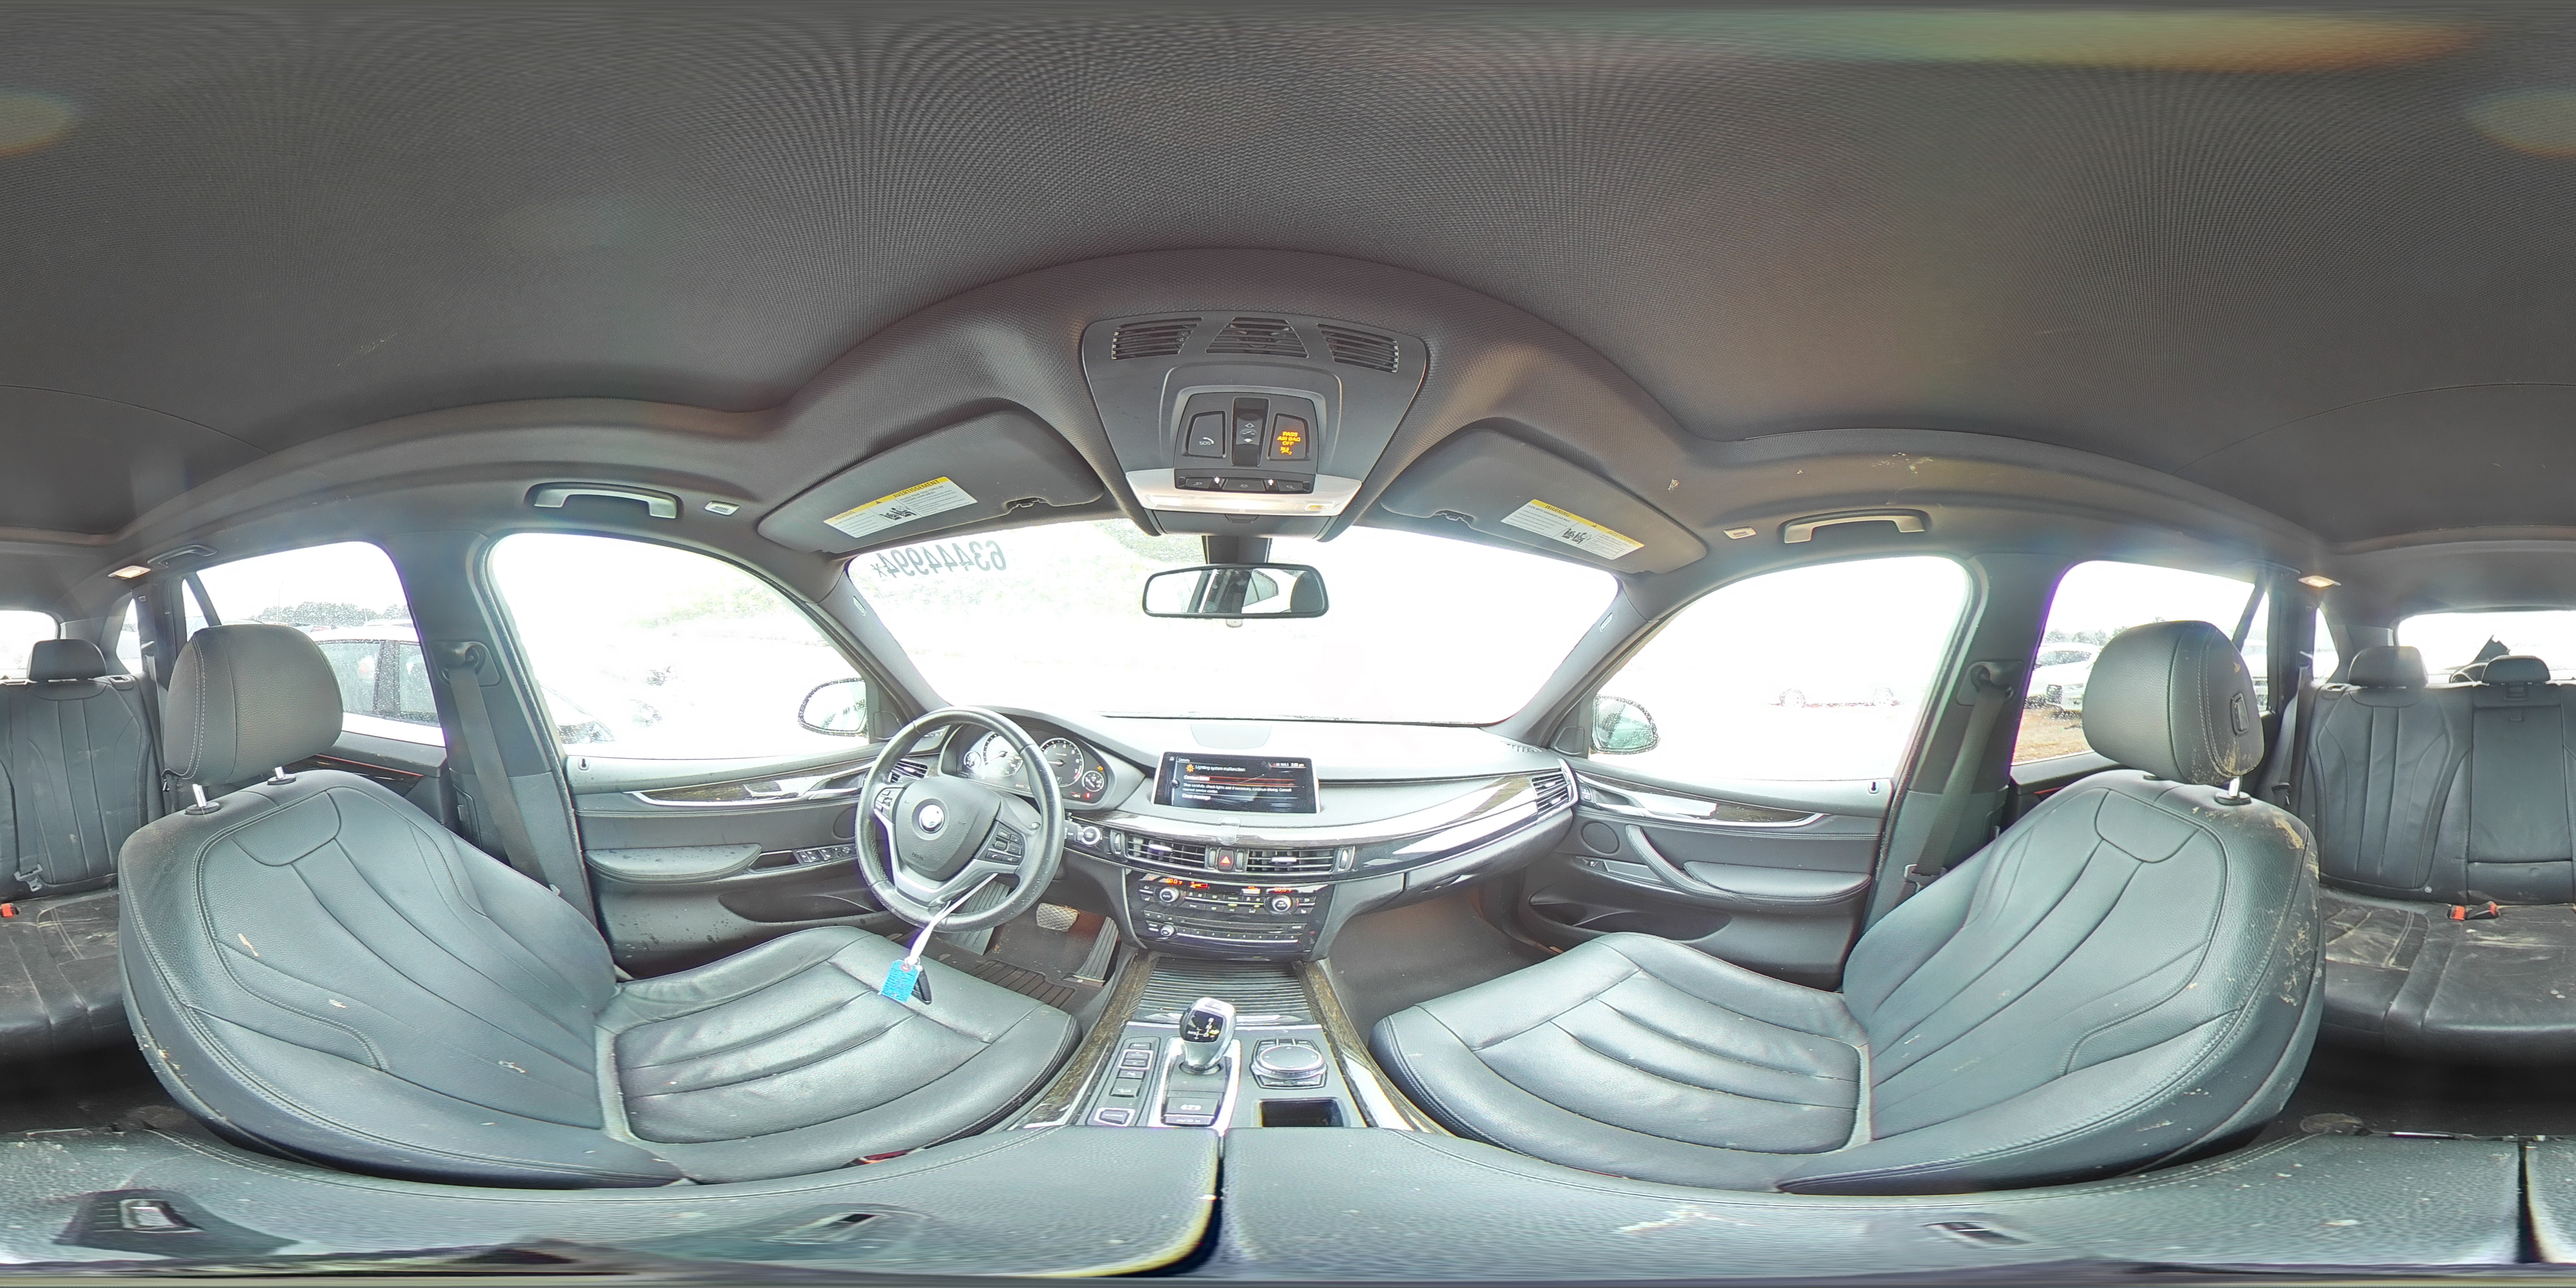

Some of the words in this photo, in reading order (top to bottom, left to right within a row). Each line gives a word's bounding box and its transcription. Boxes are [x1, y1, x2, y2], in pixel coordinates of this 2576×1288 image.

[893, 480, 940, 498] AVERTISSEMENT
[835, 510, 856, 520] WARNING
[1545, 505, 1571, 517] WARNING
